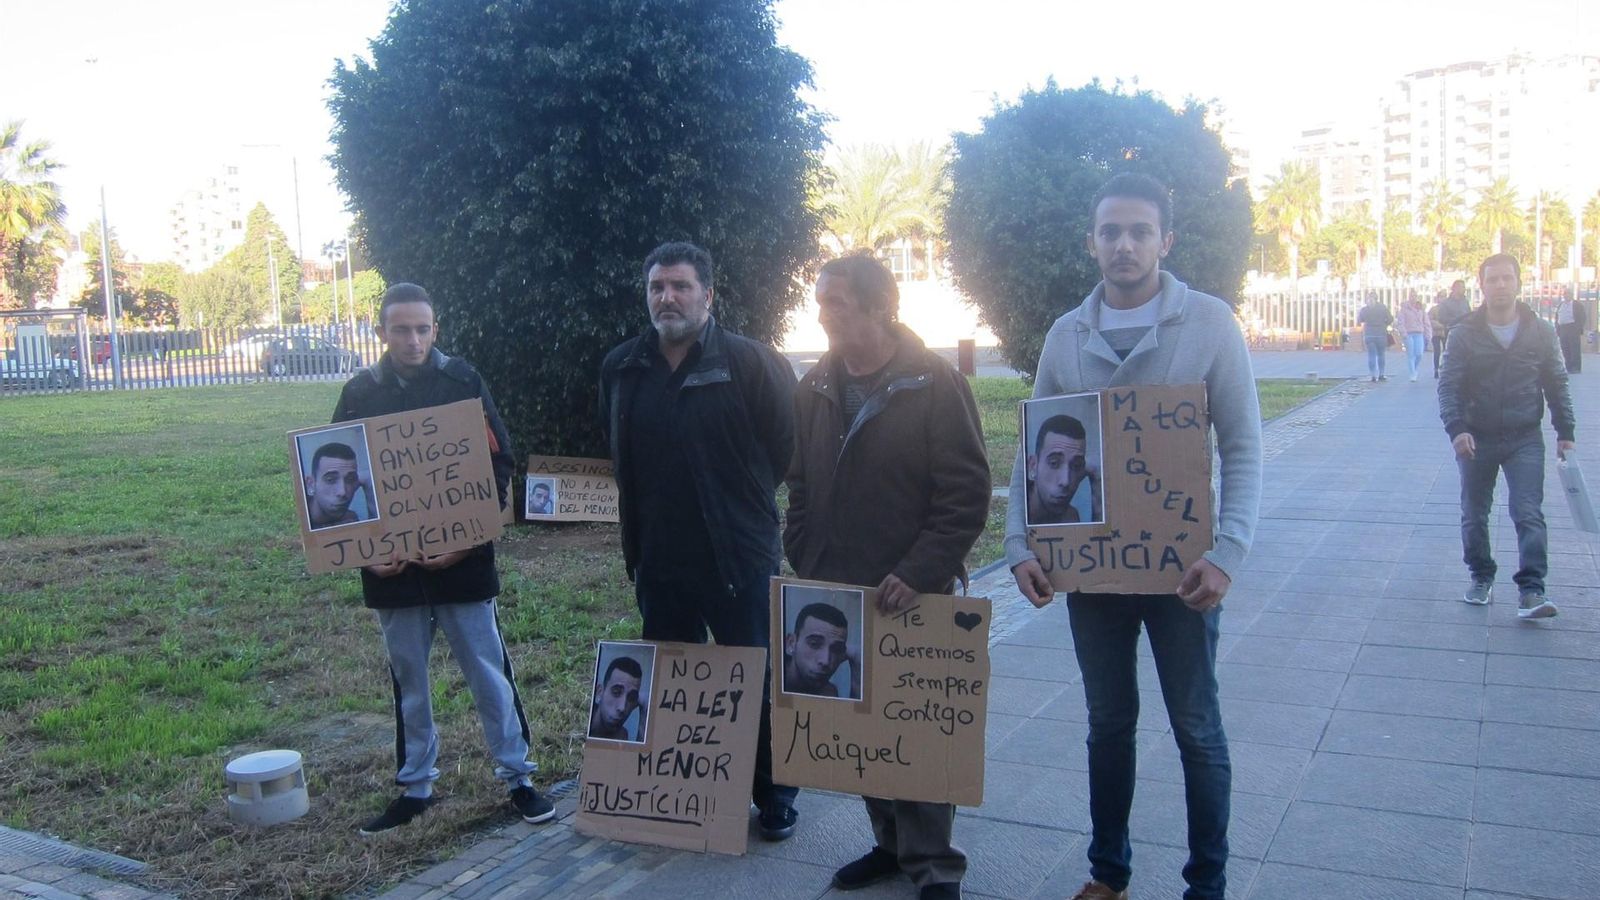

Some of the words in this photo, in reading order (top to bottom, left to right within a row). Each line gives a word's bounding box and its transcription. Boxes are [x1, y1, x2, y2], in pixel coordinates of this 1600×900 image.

[376, 416, 438, 442] TUS
[381, 473, 413, 494] NO
[425, 462, 460, 486] TE
[560, 478, 576, 489] NO
[583, 480, 591, 490] A
[595, 481, 609, 490] LA
[389, 477, 492, 517] OLVIDAN
[558, 491, 615, 503] PROTECION
[559, 503, 580, 514] DEL
[583, 504, 618, 517] MENOR
[892, 604, 925, 628] Te
[879, 633, 975, 663] Queremos
[671, 659, 711, 681] NO
[730, 662, 744, 683] A
[659, 688, 687, 712] LA
[696, 690, 744, 723] LEY
[883, 699, 974, 735] Contigo
[676, 724, 721, 744] DEL
[785, 711, 911, 779] Maiquel
[637, 747, 732, 782] MENOR
